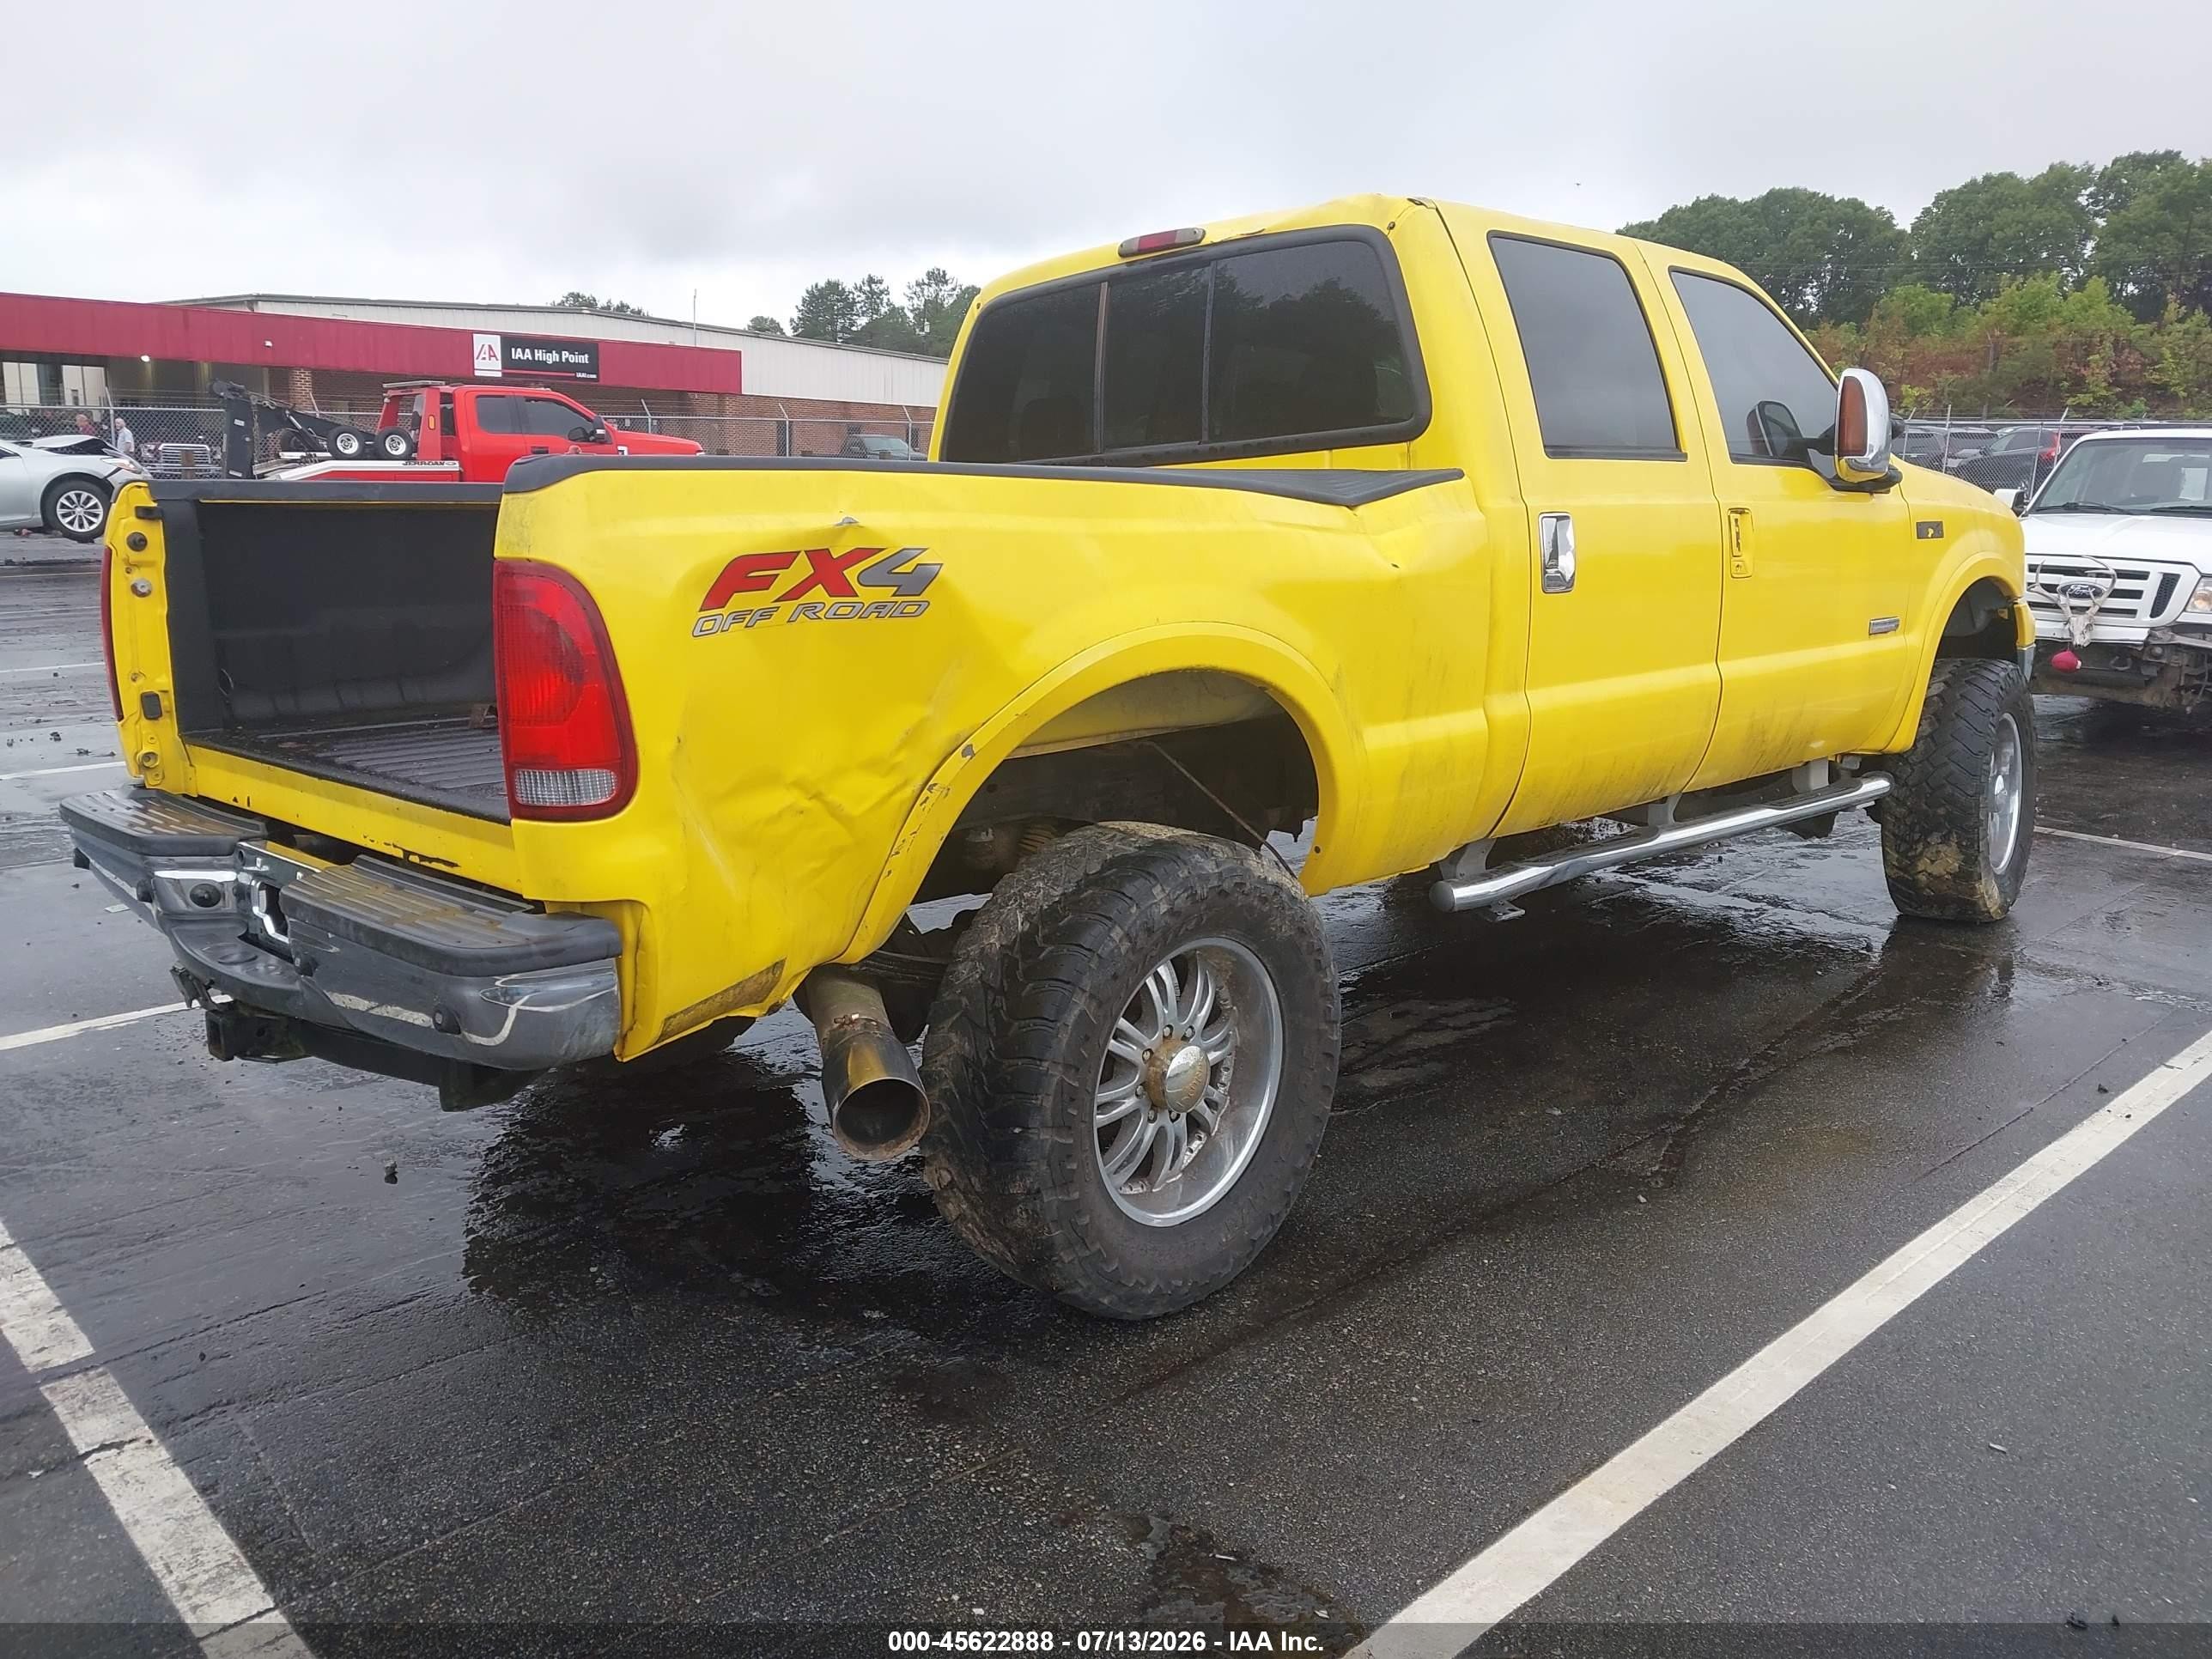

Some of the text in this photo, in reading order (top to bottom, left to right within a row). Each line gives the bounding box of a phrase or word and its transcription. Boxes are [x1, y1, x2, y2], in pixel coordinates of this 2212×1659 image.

[511, 347, 589, 364] IAA High Point
[698, 547, 944, 612] FX4
[691, 600, 931, 638] OFF ROAD
